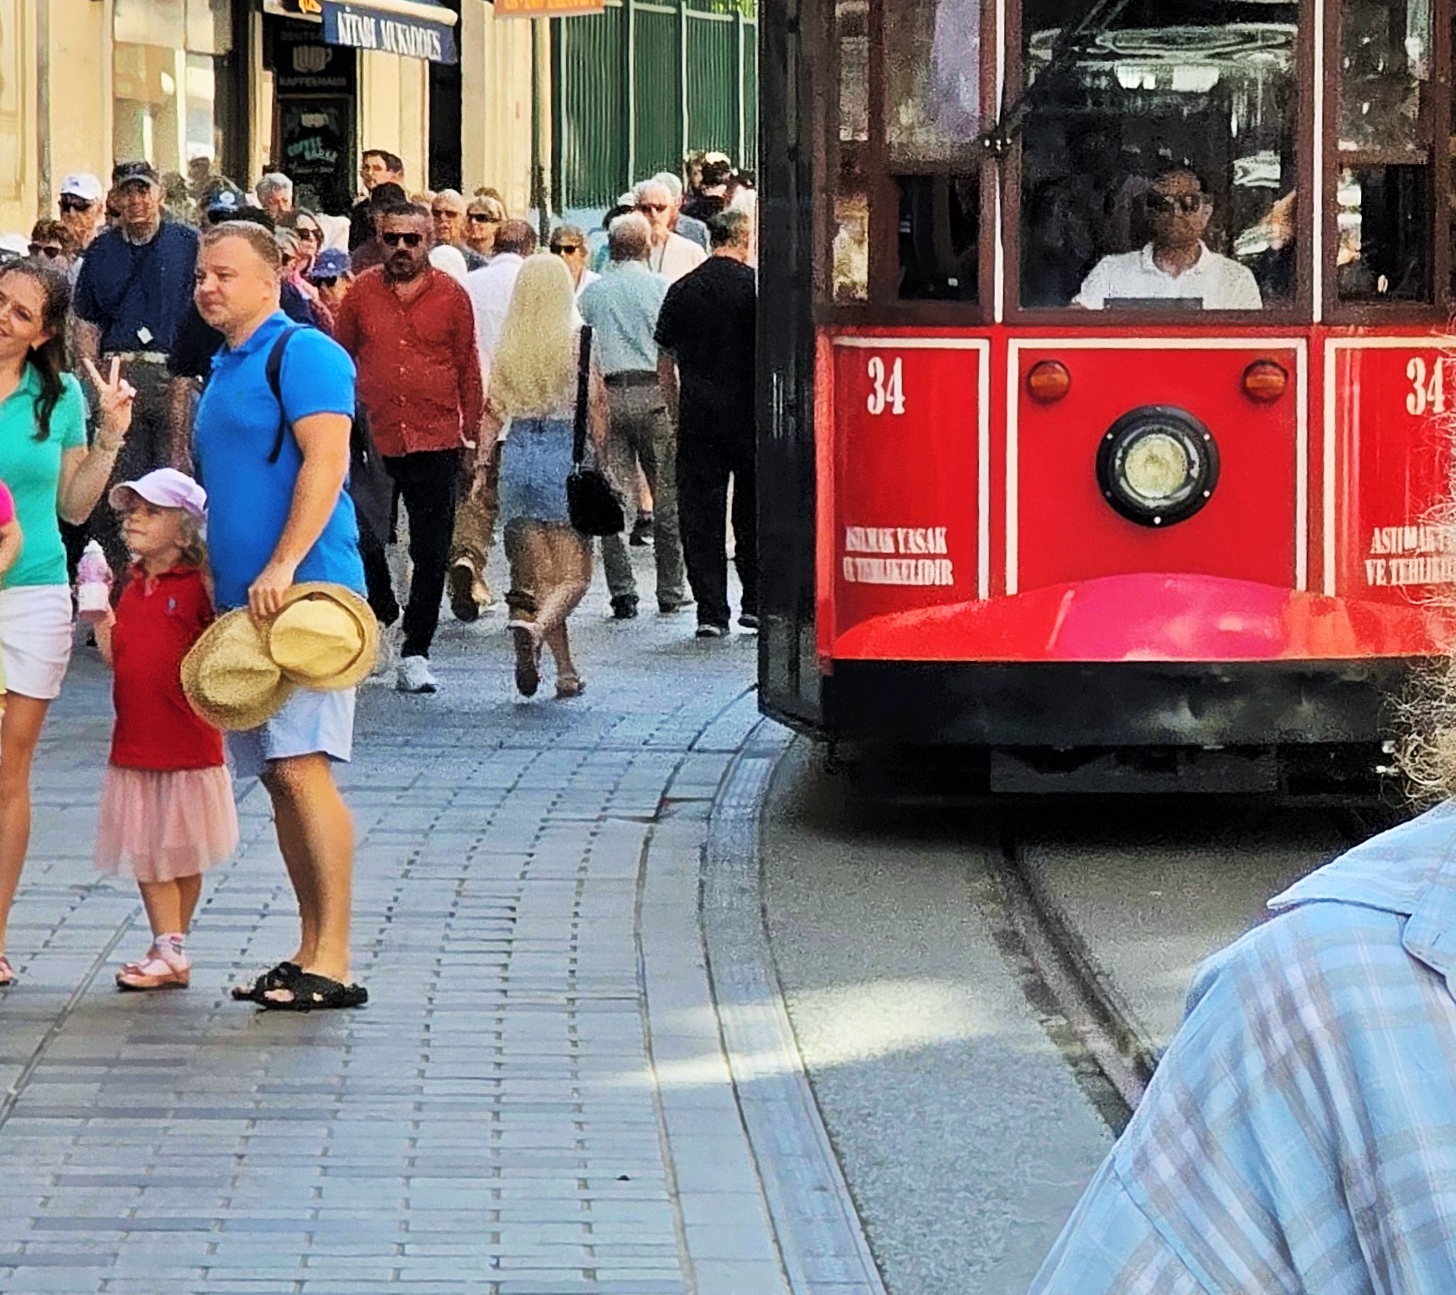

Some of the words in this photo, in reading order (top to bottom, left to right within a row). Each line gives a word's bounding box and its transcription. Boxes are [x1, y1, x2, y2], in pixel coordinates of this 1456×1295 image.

[867, 356, 906, 416] 34
[1406, 356, 1445, 416] 34
[1364, 558, 1387, 586] VE
